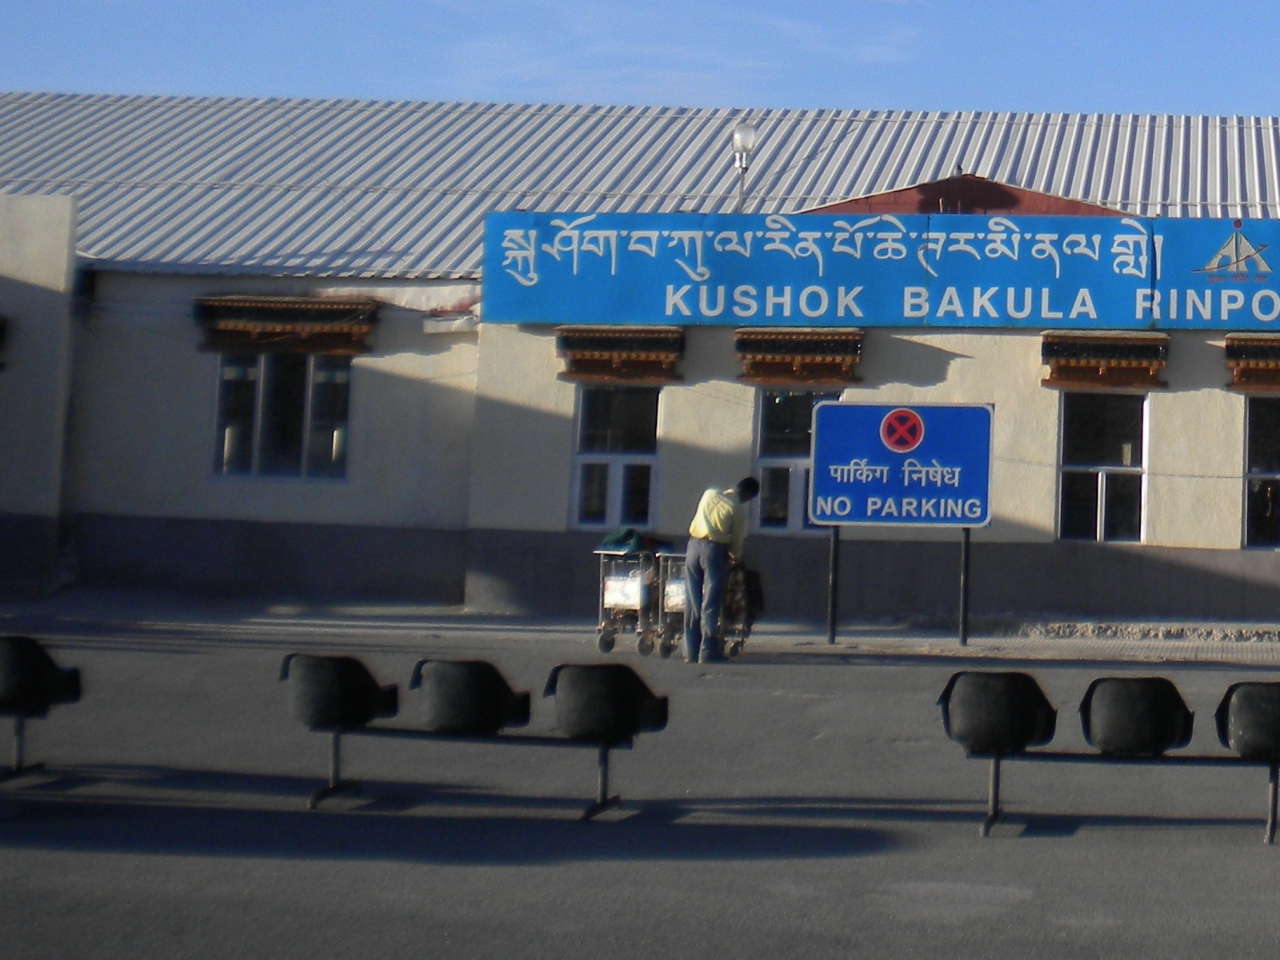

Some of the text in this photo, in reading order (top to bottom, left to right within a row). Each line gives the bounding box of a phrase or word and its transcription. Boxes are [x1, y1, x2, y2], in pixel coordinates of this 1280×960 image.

[665, 284, 863, 318] KUSHOK
[903, 286, 1098, 320] BAKULA
[902, 458, 961, 488] निषेध
[816, 496, 982, 519] NO PARKING
